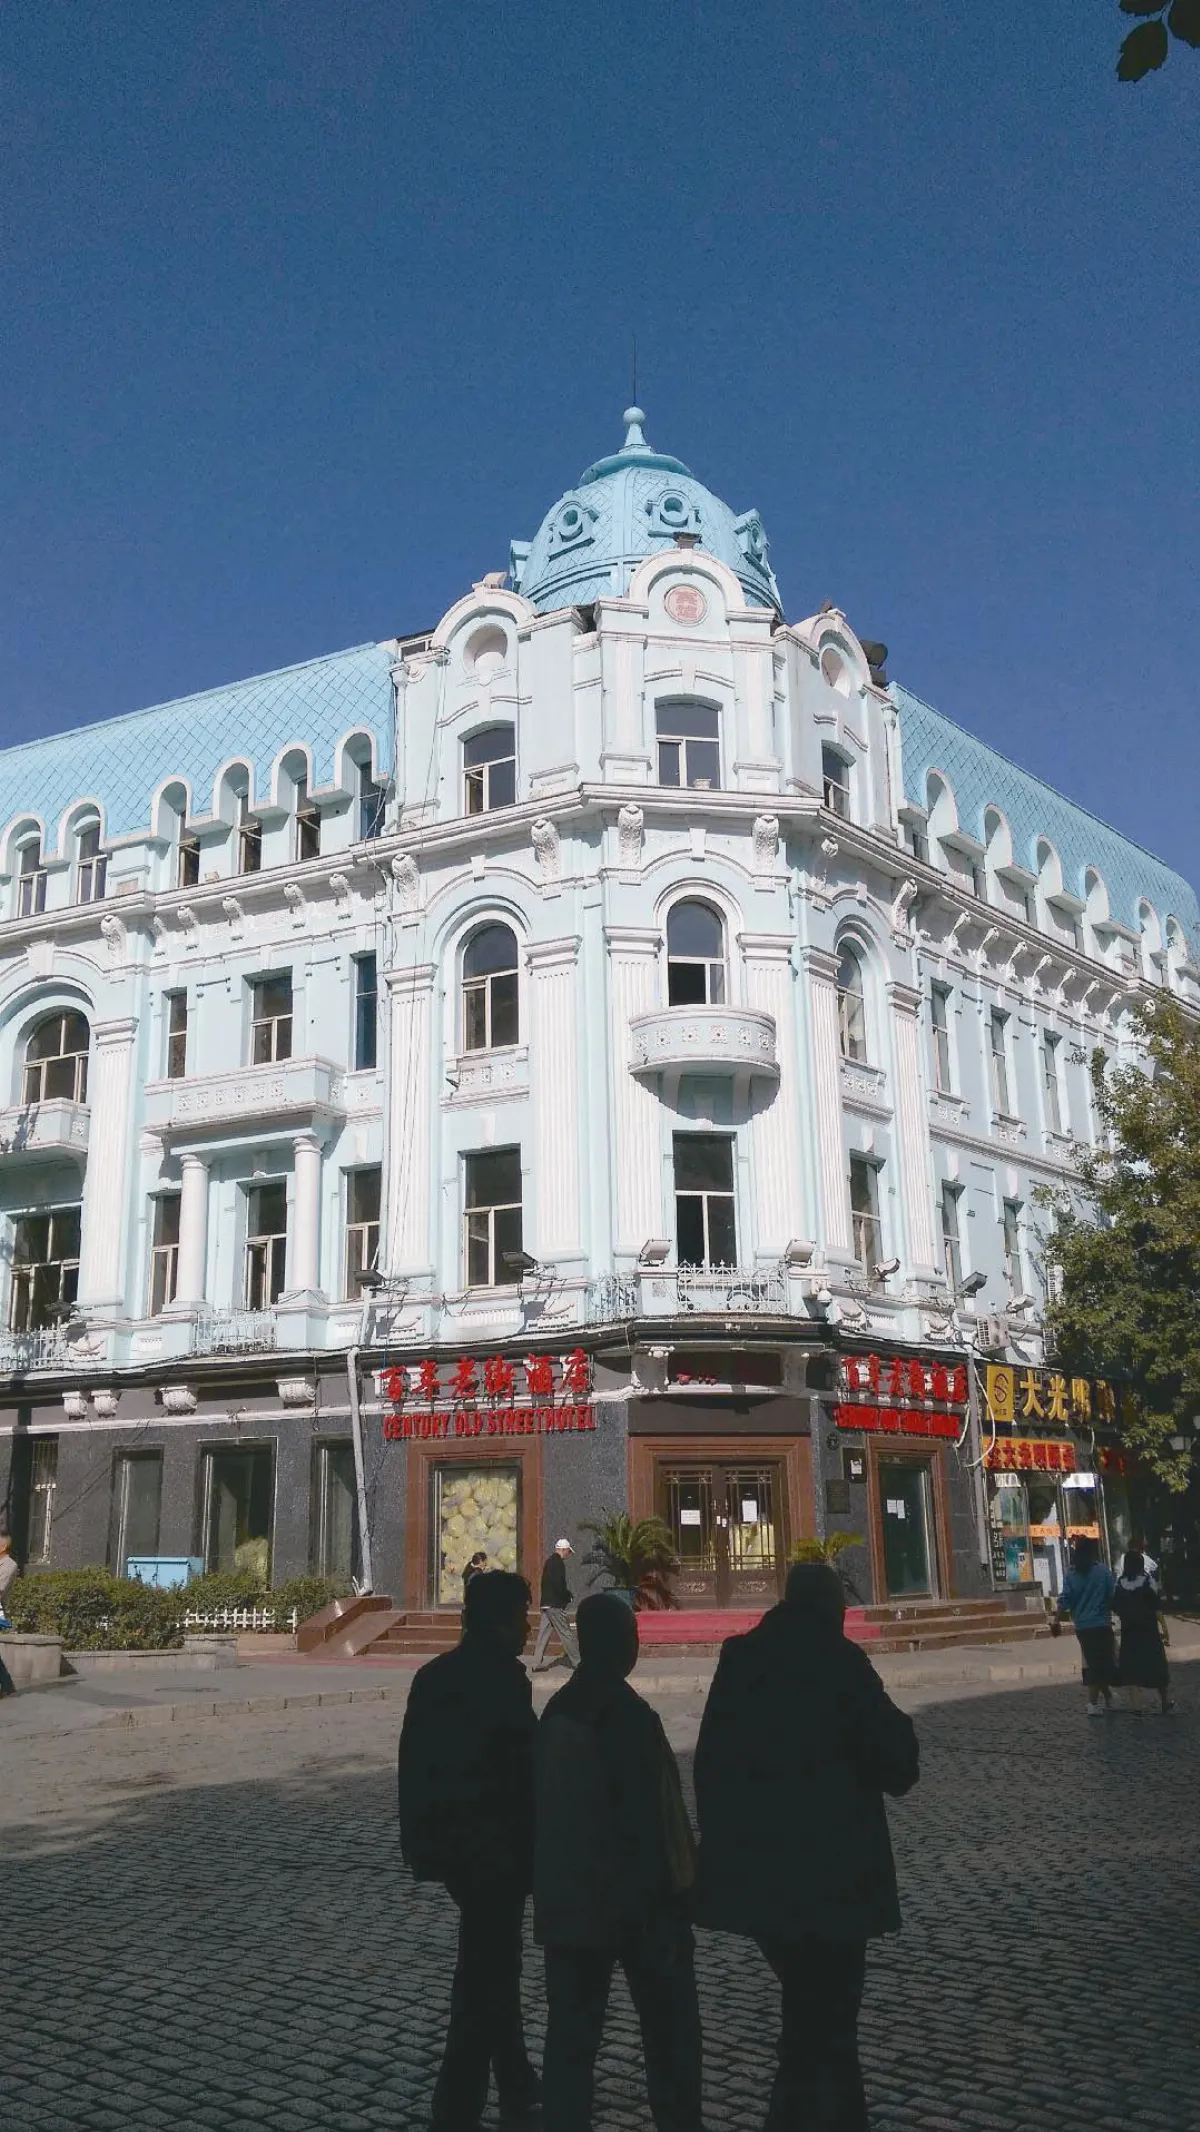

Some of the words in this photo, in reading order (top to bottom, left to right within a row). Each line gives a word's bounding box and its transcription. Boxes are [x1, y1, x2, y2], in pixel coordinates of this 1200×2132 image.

[379, 1348, 588, 1401] 百年老街酒店
[383, 1413, 449, 1440] CENTURY
[454, 1410, 484, 1436] OLD
[486, 1408, 543, 1433] STREET
[543, 1405, 593, 1432] HOTEL
